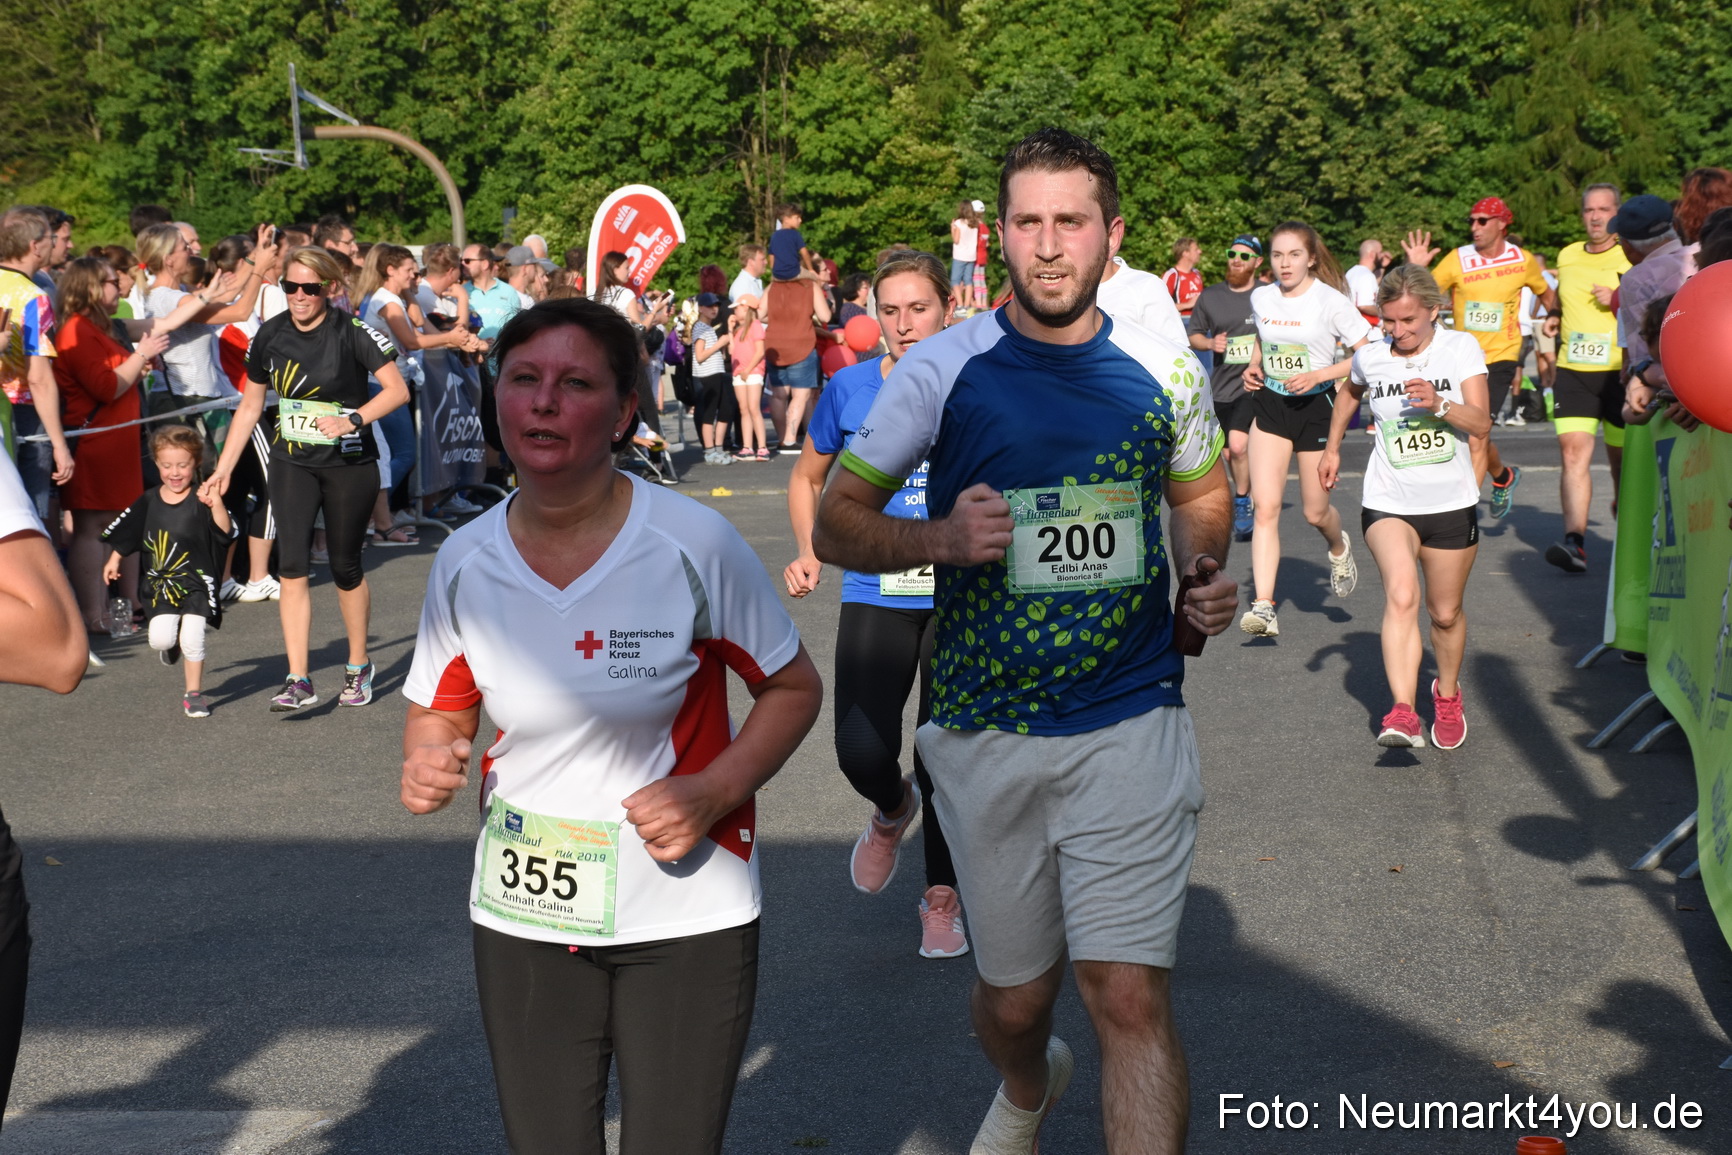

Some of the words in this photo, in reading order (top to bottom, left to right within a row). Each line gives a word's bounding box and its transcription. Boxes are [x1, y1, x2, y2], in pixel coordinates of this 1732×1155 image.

[1463, 272, 1491, 285] MAX
[1496, 265, 1526, 278] BÖGL
[1271, 319, 1303, 328] KLEBL
[1469, 312, 1498, 324] 1599
[1228, 346, 1250, 357] 411
[1572, 343, 1605, 357] 2192
[1268, 356, 1304, 370] 1184
[1394, 430, 1446, 454] 1495
[1027, 506, 1082, 519] firmenlauf
[1114, 509, 1135, 519] 2019
[1037, 521, 1116, 563] 200
[1051, 563, 1079, 574] Edlbi
[1081, 562, 1108, 572] Anas
[1056, 574, 1092, 582] Bionorica
[609, 629, 675, 640] Bayerisches
[609, 639, 641, 649] Rotes
[609, 650, 641, 659] Kreuz
[608, 664, 658, 679] Galina
[497, 823, 543, 847] firmenlauf
[577, 852, 606, 863] 2019
[500, 848, 578, 901] 355
[502, 890, 535, 907] Anhalt
[537, 900, 574, 914] Galina
